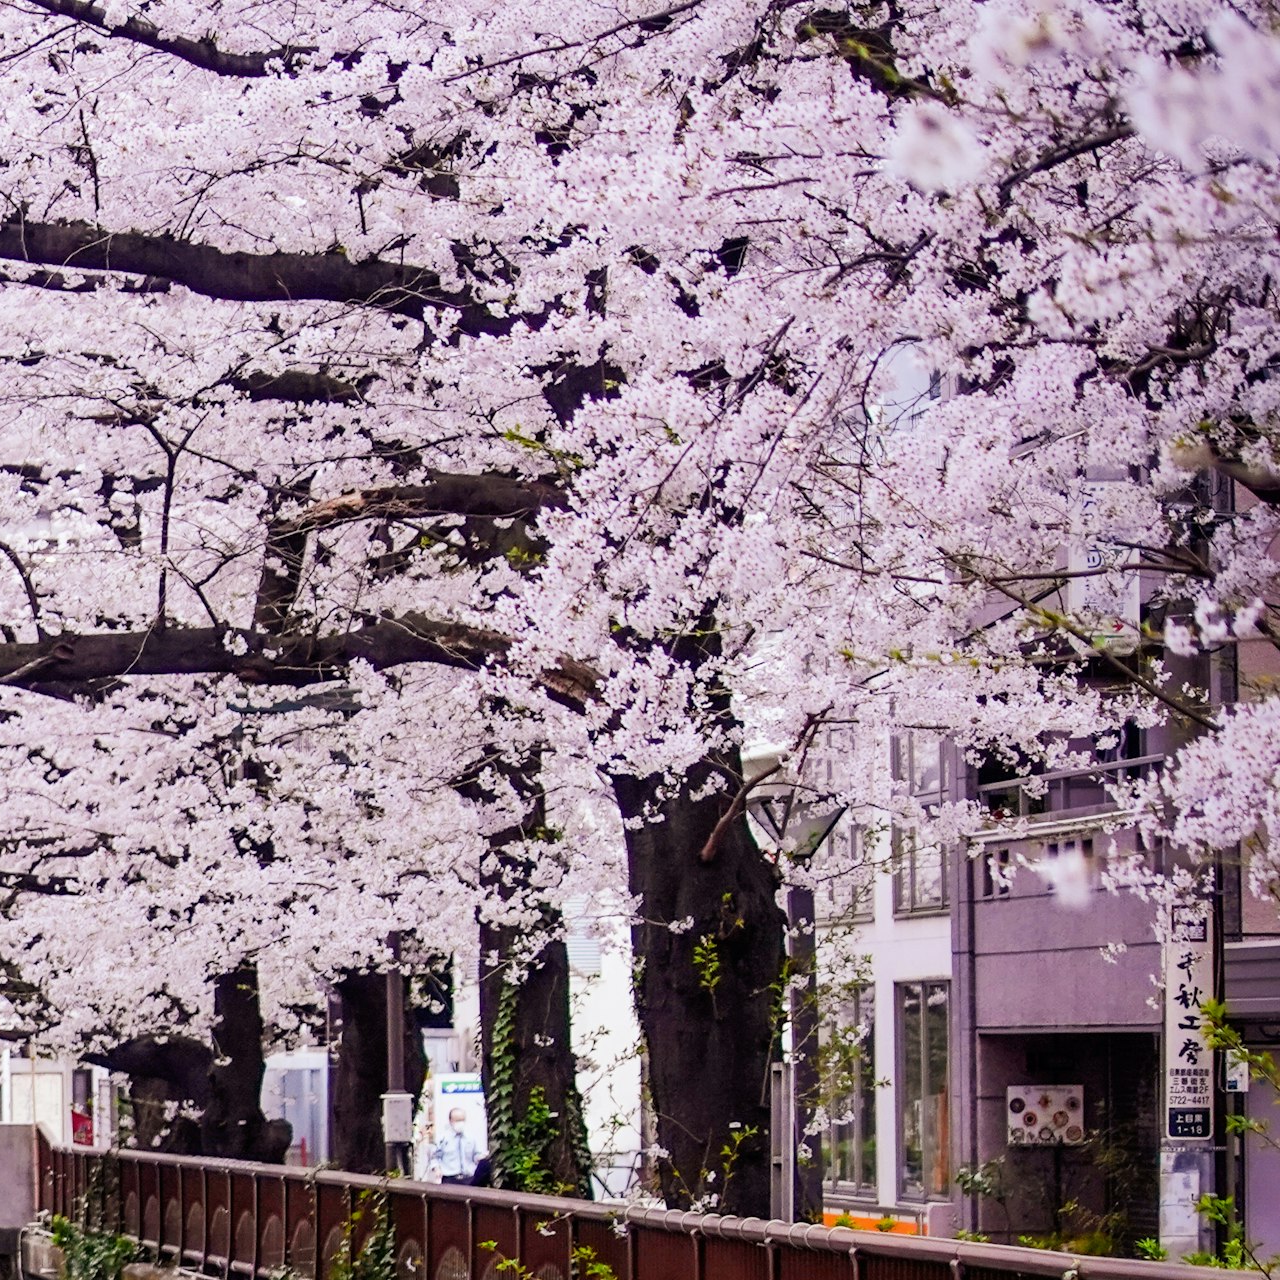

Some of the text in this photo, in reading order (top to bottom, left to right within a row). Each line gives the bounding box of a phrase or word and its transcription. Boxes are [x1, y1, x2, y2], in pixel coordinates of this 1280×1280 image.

[1169, 1096, 1210, 1104] 5722-4417
[1176, 1114, 1203, 1123] 上目黒
[1177, 1126, 1203, 1134] 1-18
